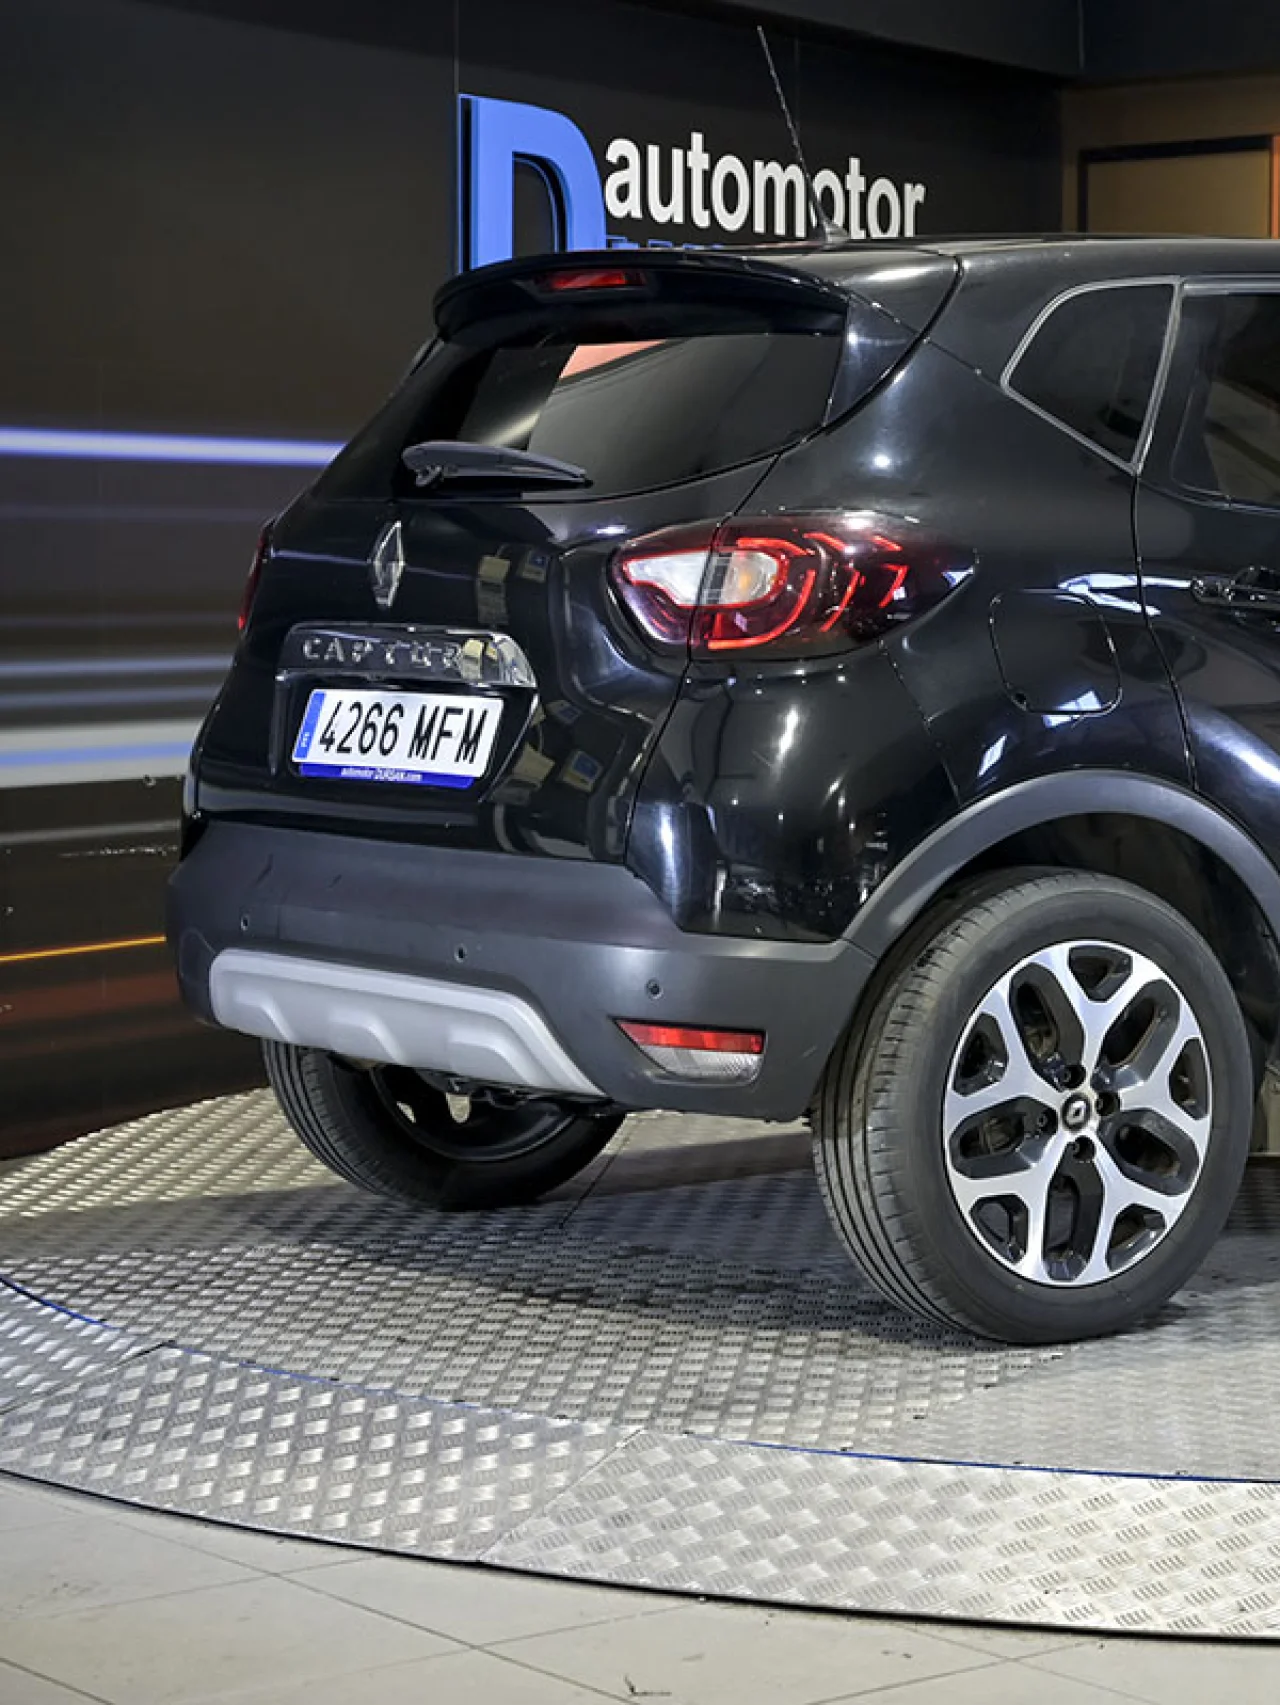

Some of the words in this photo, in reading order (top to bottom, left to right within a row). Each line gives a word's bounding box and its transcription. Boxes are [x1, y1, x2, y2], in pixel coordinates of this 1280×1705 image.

[604, 131, 926, 240] automotor
[302, 637, 462, 668] CAPTUR
[319, 699, 405, 757] 4266
[407, 703, 488, 764] MFM
